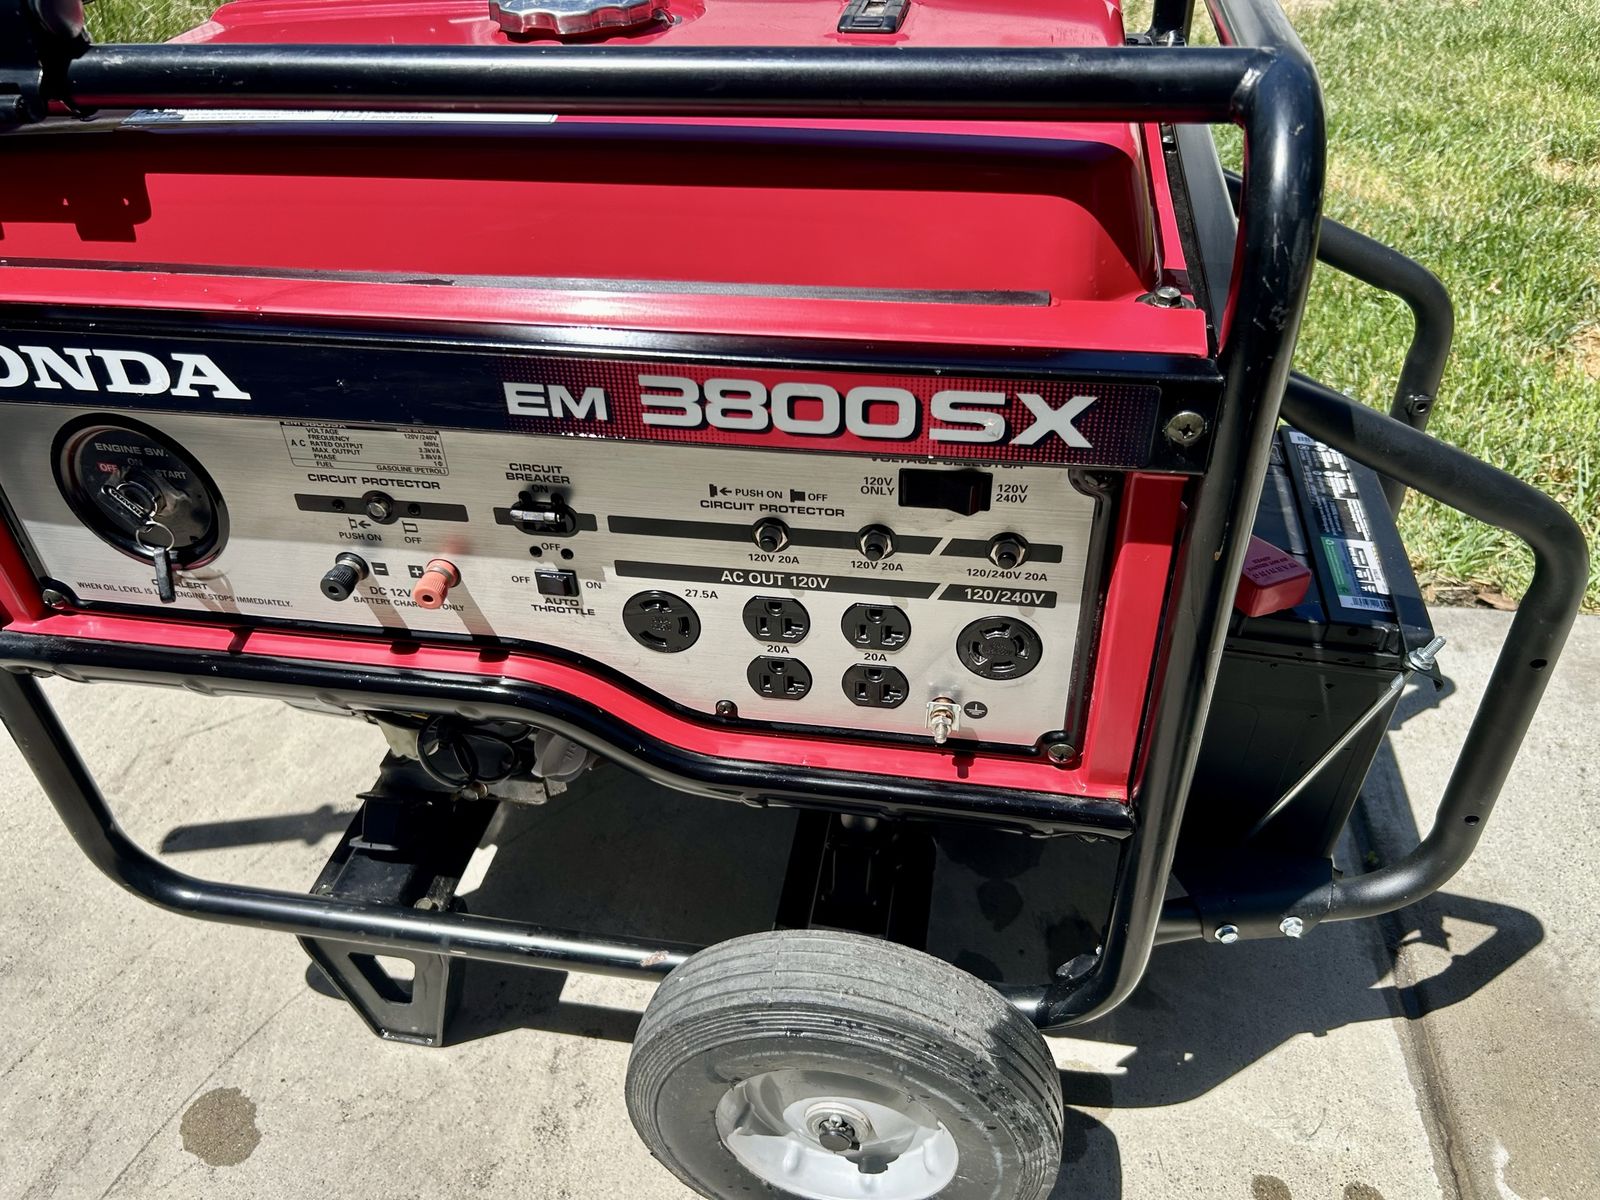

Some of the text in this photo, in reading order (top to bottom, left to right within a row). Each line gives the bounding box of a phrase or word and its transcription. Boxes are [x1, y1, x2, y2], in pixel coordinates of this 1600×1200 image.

[502, 373, 1099, 448] EM 3800SX
[308, 434, 350, 442] FREQUENCY
[94, 442, 169, 457] ENGINE SW.
[310, 440, 334, 448] RATED
[100, 463, 119, 472] OFF
[127, 458, 143, 467] ON
[376, 464, 412, 473] GASOLINE
[509, 463, 563, 474] CIRCUIT
[154, 469, 187, 480] START
[505, 472, 571, 484] BREAKER
[308, 473, 441, 489] CIRCUIT PROTECTOR
[863, 476, 893, 486] 120V
[531, 484, 549, 493] ON
[735, 488, 783, 499] PUSH ON
[860, 485, 895, 496] ONLY
[997, 484, 1029, 494] 120V
[807, 493, 828, 501] OFF
[996, 494, 1028, 504] 240V
[700, 500, 845, 517] CIRCUIT PROTECTOR
[339, 531, 382, 542] PUSH ON
[404, 536, 422, 544] OFF
[541, 542, 561, 551] OFF
[748, 554, 800, 564] 120V 20A
[850, 560, 904, 571] 120V 20A
[511, 575, 531, 584] OFF
[721, 570, 830, 589] AC OUT 120V
[966, 568, 1048, 581] 120/240V 20A
[585, 581, 602, 589] ON
[77, 581, 103, 589] WHEN
[105, 583, 117, 592] OIL
[118, 584, 143, 594] LEVEL
[175, 590, 207, 600] ENGINE
[208, 594, 235, 602] STOPS
[236, 596, 294, 608] IMMEDIATELY.
[369, 586, 412, 598] DC 12V
[684, 588, 719, 599] 27.5A
[964, 588, 1046, 605] 120/240V
[353, 596, 391, 606] BATTERY
[442, 603, 465, 612] ONLY
[544, 597, 580, 607] AUTO
[531, 604, 595, 616] THROTTLE
[767, 644, 790, 654] 20A
[864, 652, 888, 662] 20A
